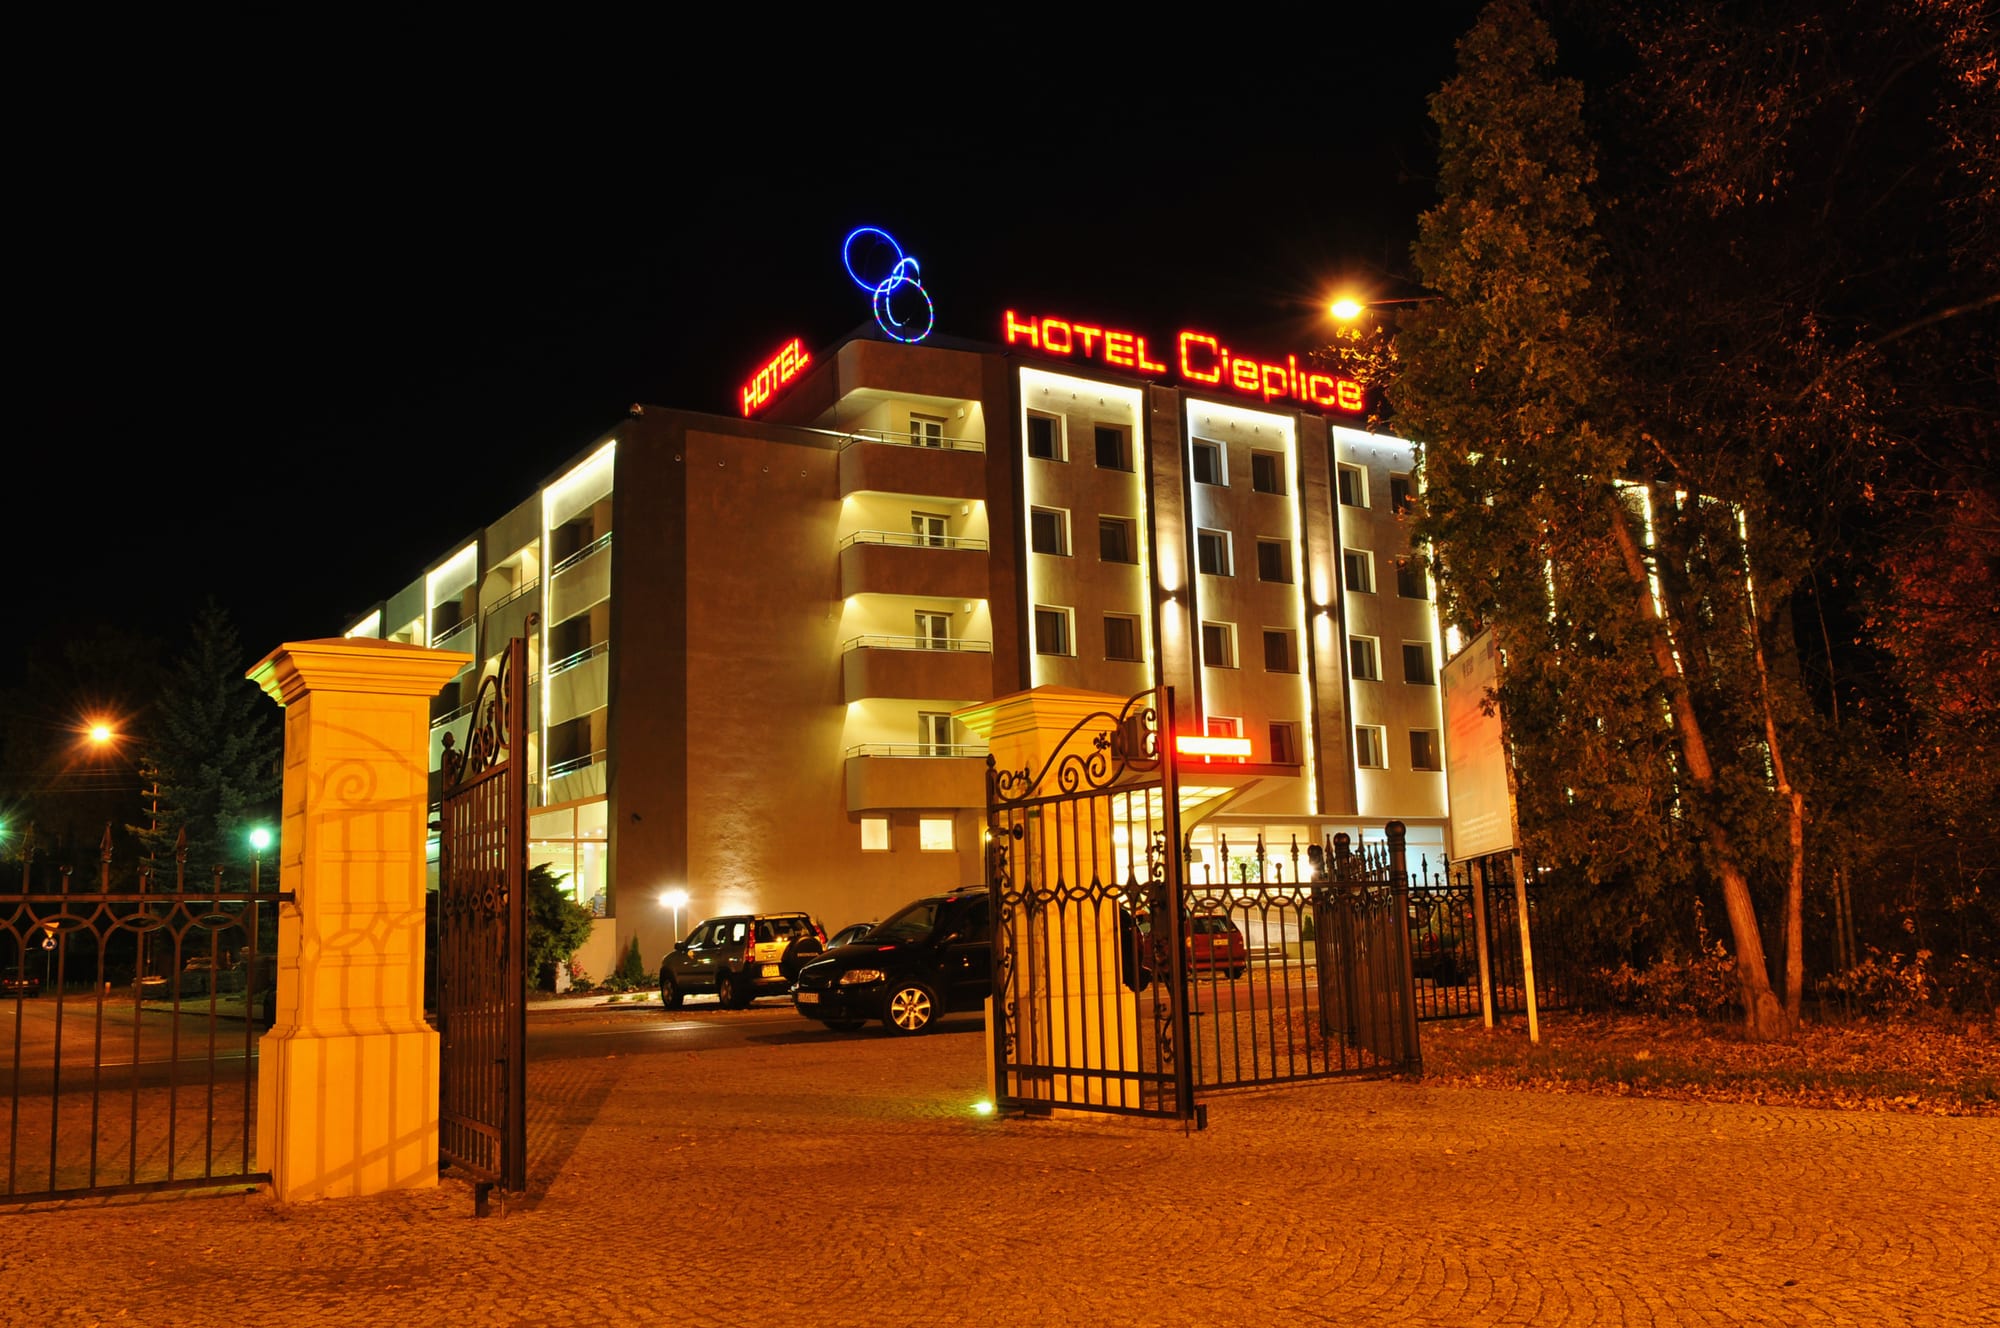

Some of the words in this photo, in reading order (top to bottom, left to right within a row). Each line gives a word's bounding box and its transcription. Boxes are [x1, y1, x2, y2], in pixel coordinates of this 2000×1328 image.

[742, 337, 810, 417] HOTEL
[1004, 310, 1168, 375] HOTEL
[1177, 330, 1365, 412] Cieplice
